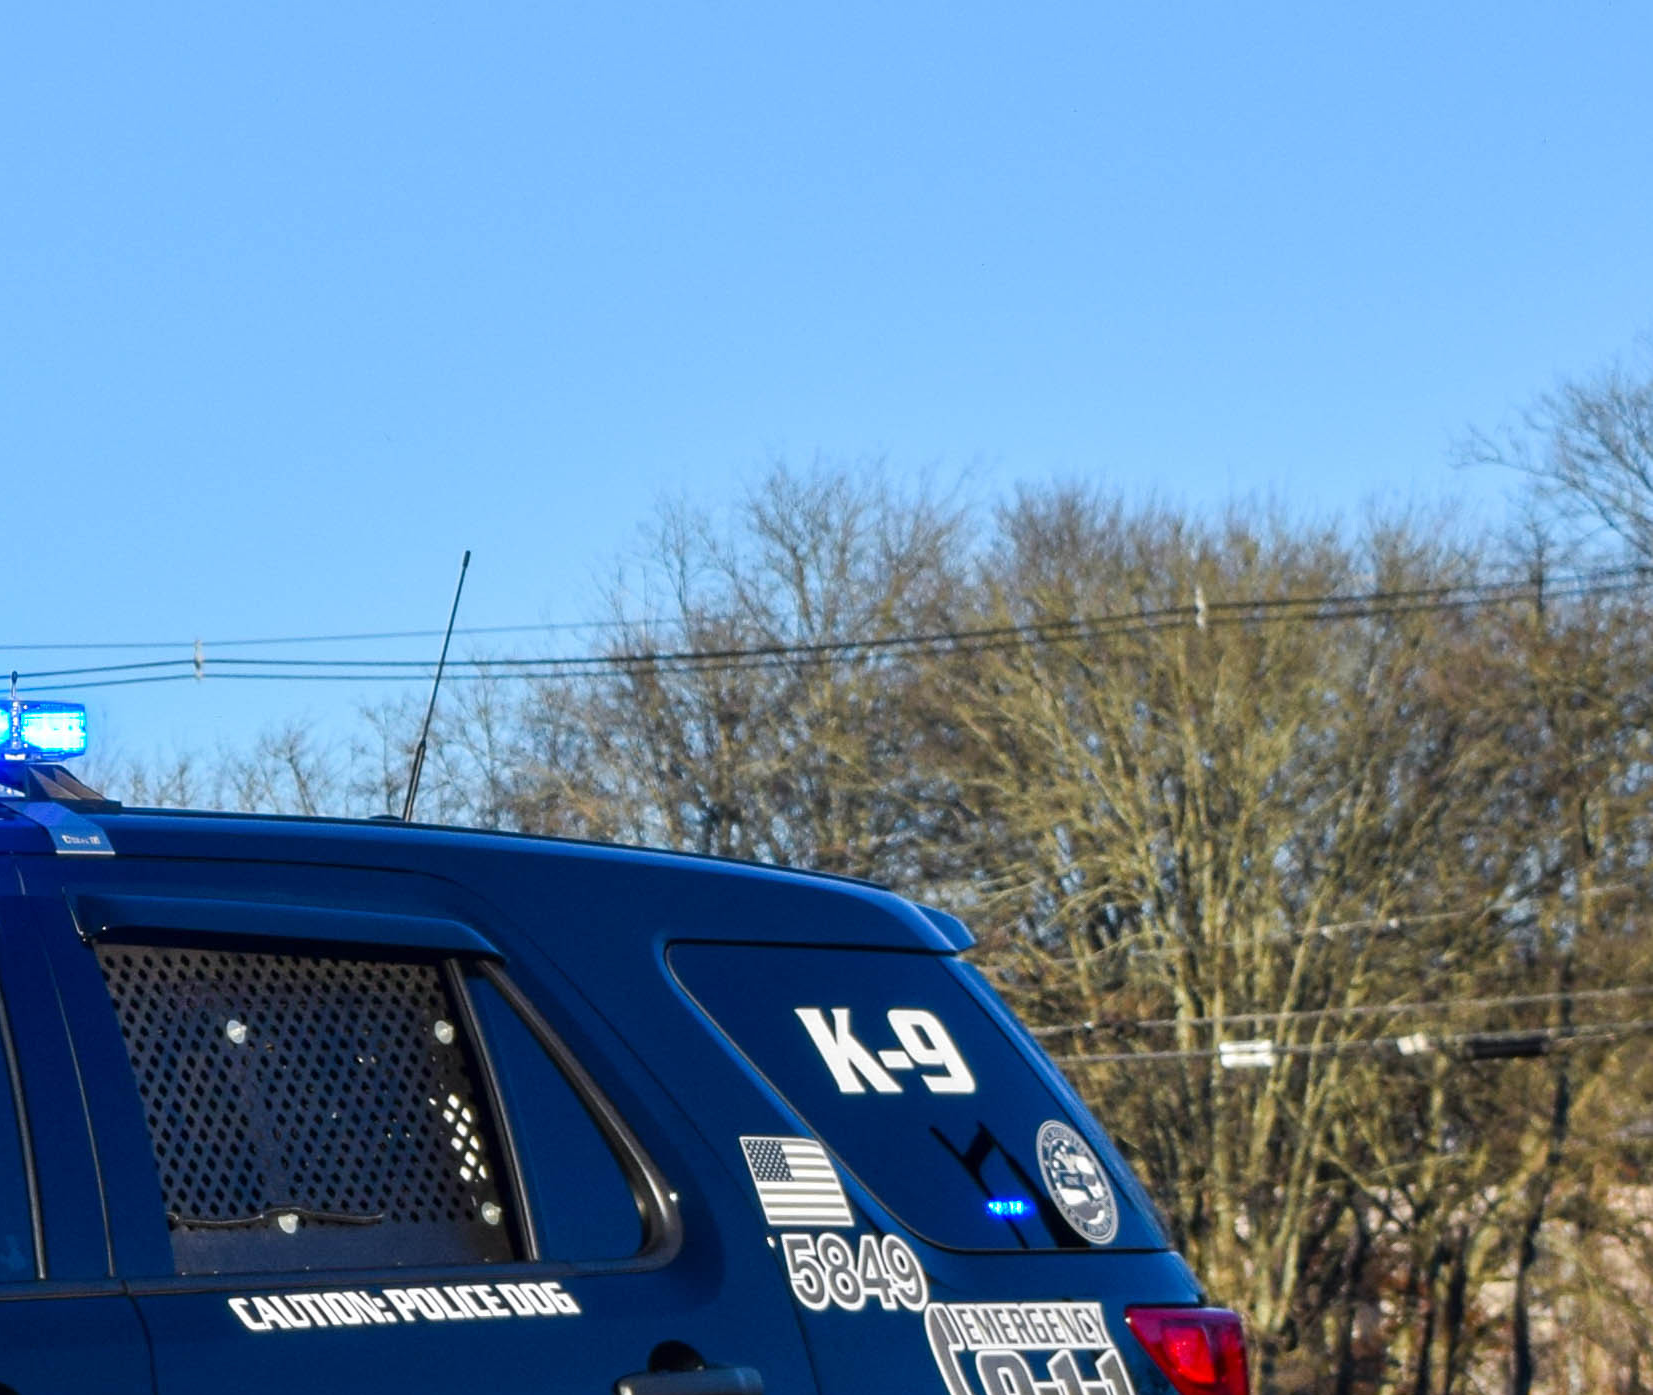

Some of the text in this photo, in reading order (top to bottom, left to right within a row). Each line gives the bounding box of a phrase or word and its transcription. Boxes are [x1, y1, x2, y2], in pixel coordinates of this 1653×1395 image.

[794, 1008, 976, 1093] K-9
[780, 1232, 928, 1312] 5849
[228, 1281, 582, 1331] CAUTION: POLICE DOG
[950, 1303, 1112, 1349] EMERGENCY
